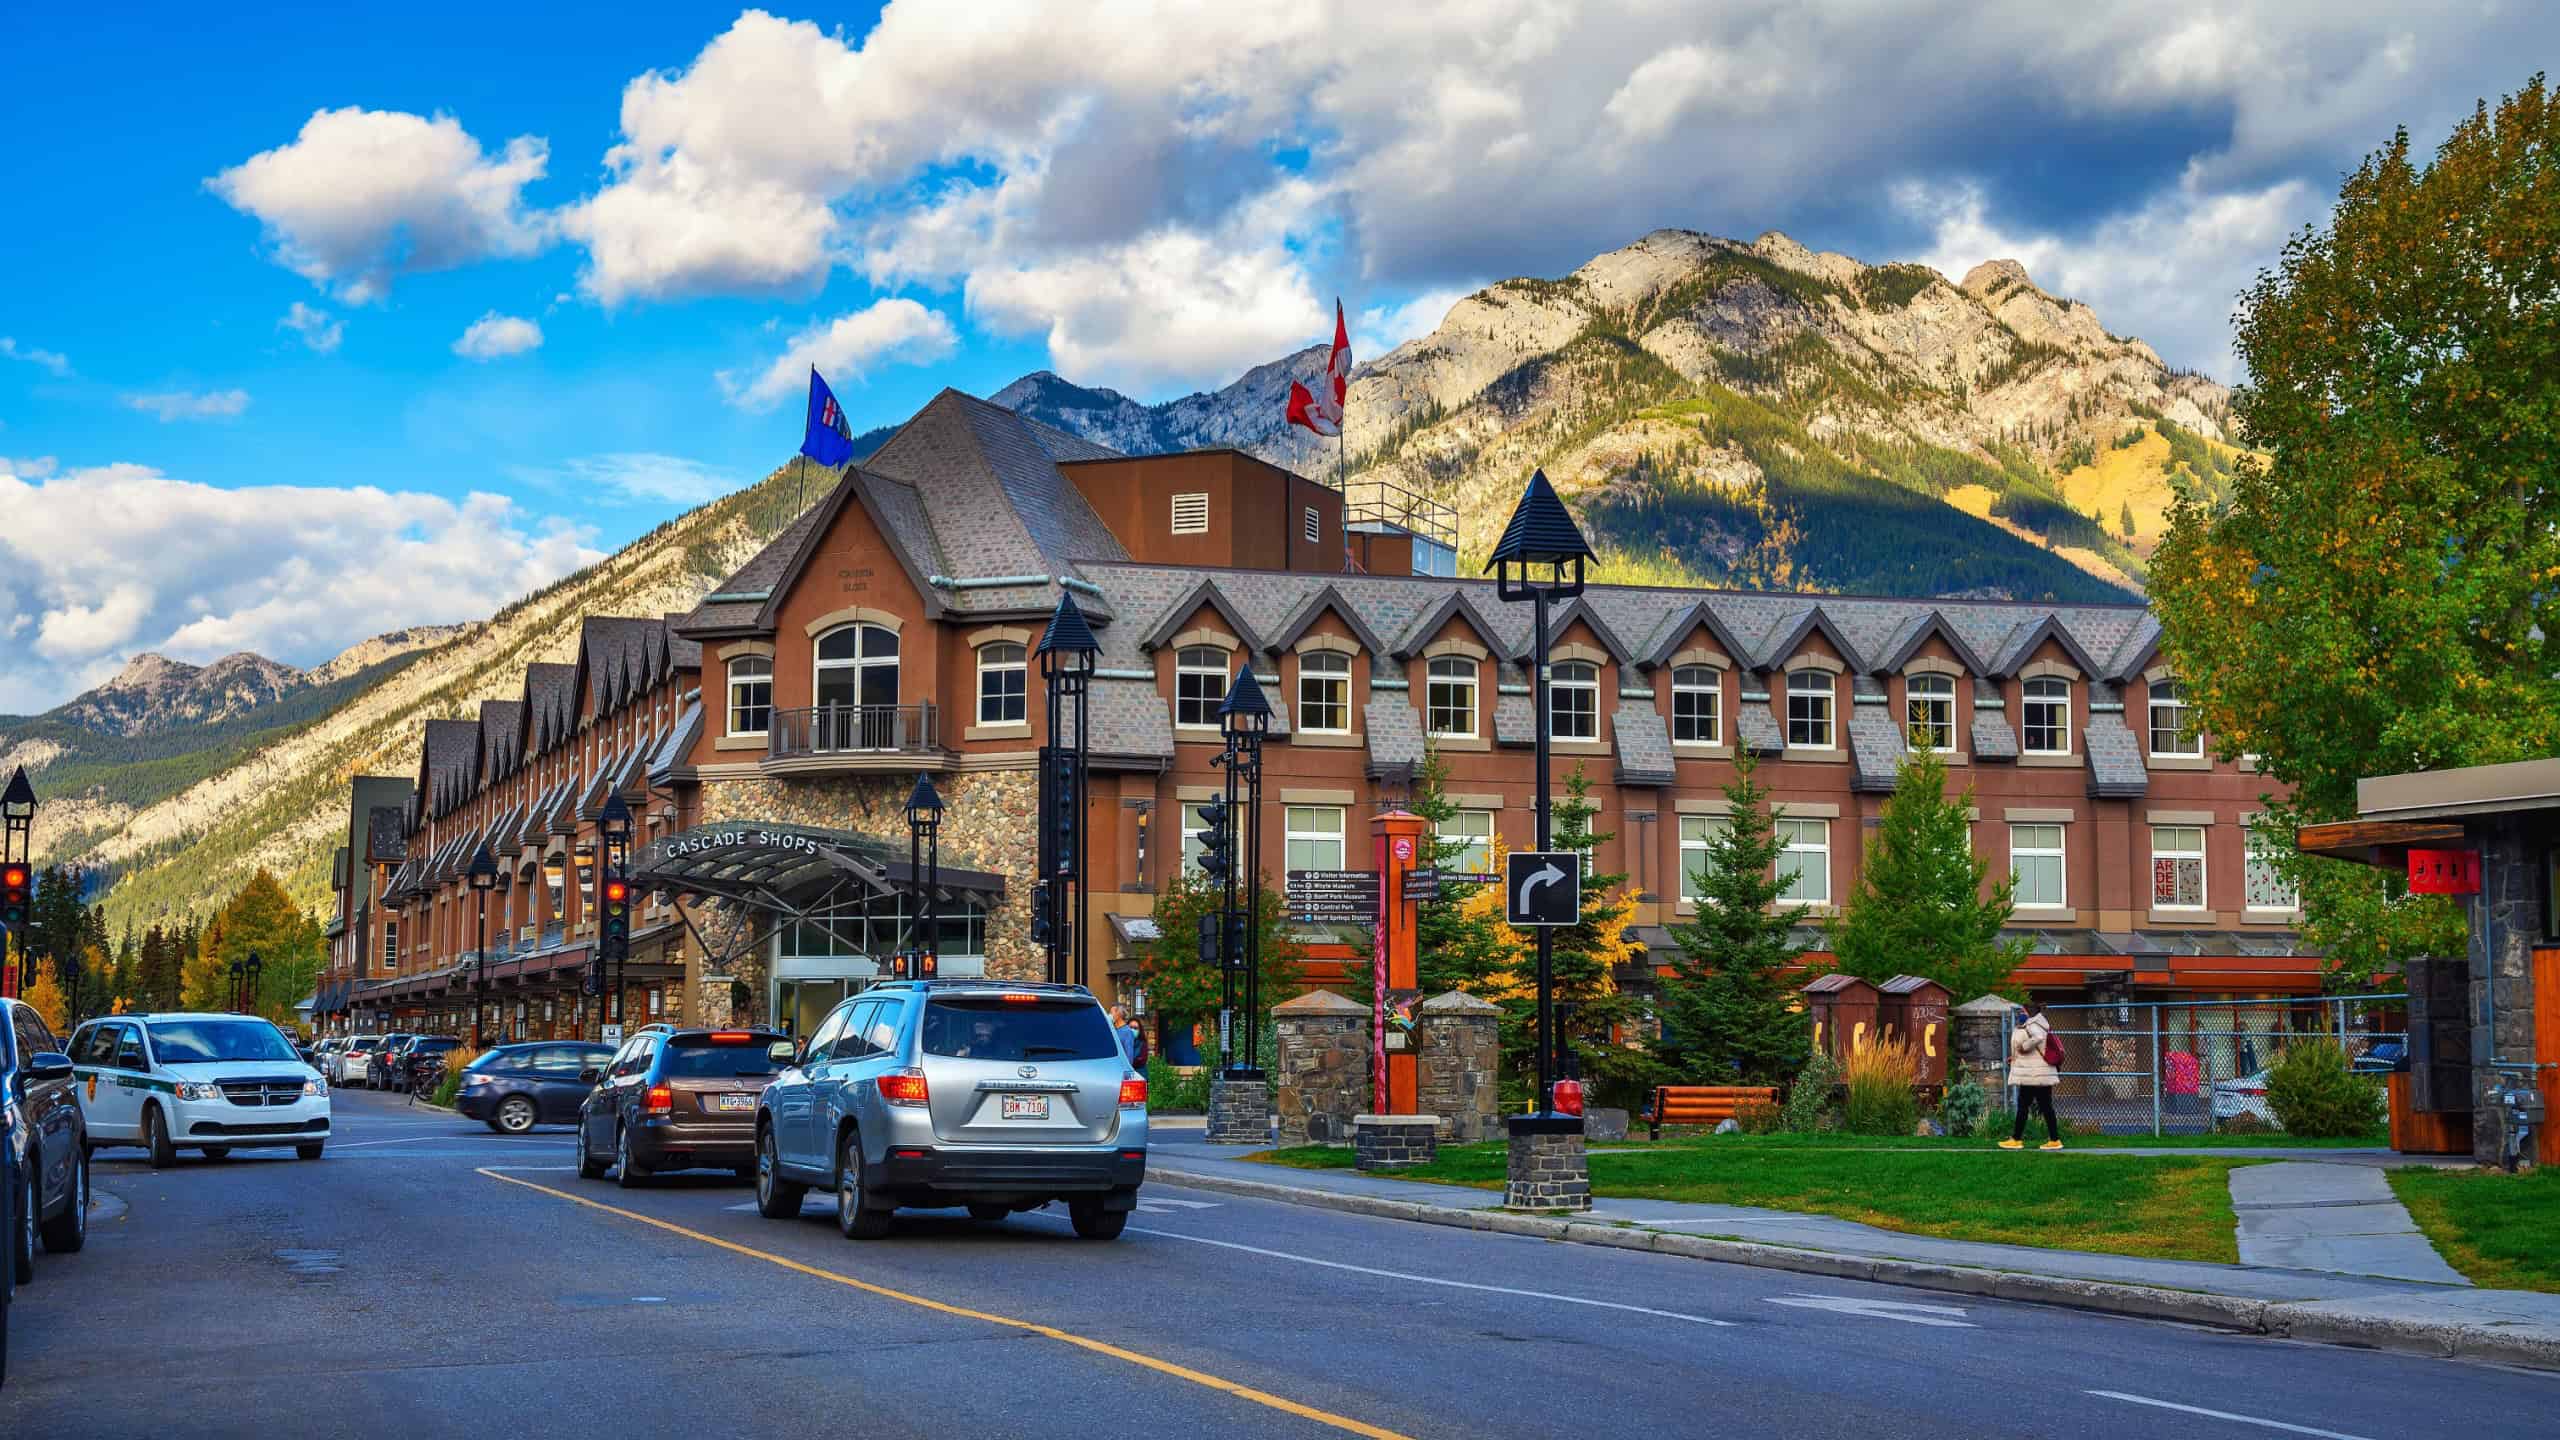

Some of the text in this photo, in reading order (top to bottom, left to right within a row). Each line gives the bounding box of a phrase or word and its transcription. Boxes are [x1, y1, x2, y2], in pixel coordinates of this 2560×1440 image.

[666, 831, 818, 858] CASCADE SHOPS
[2156, 860, 2174, 871] AR
[2156, 872, 2174, 883] DE
[2156, 884, 2174, 896] NE
